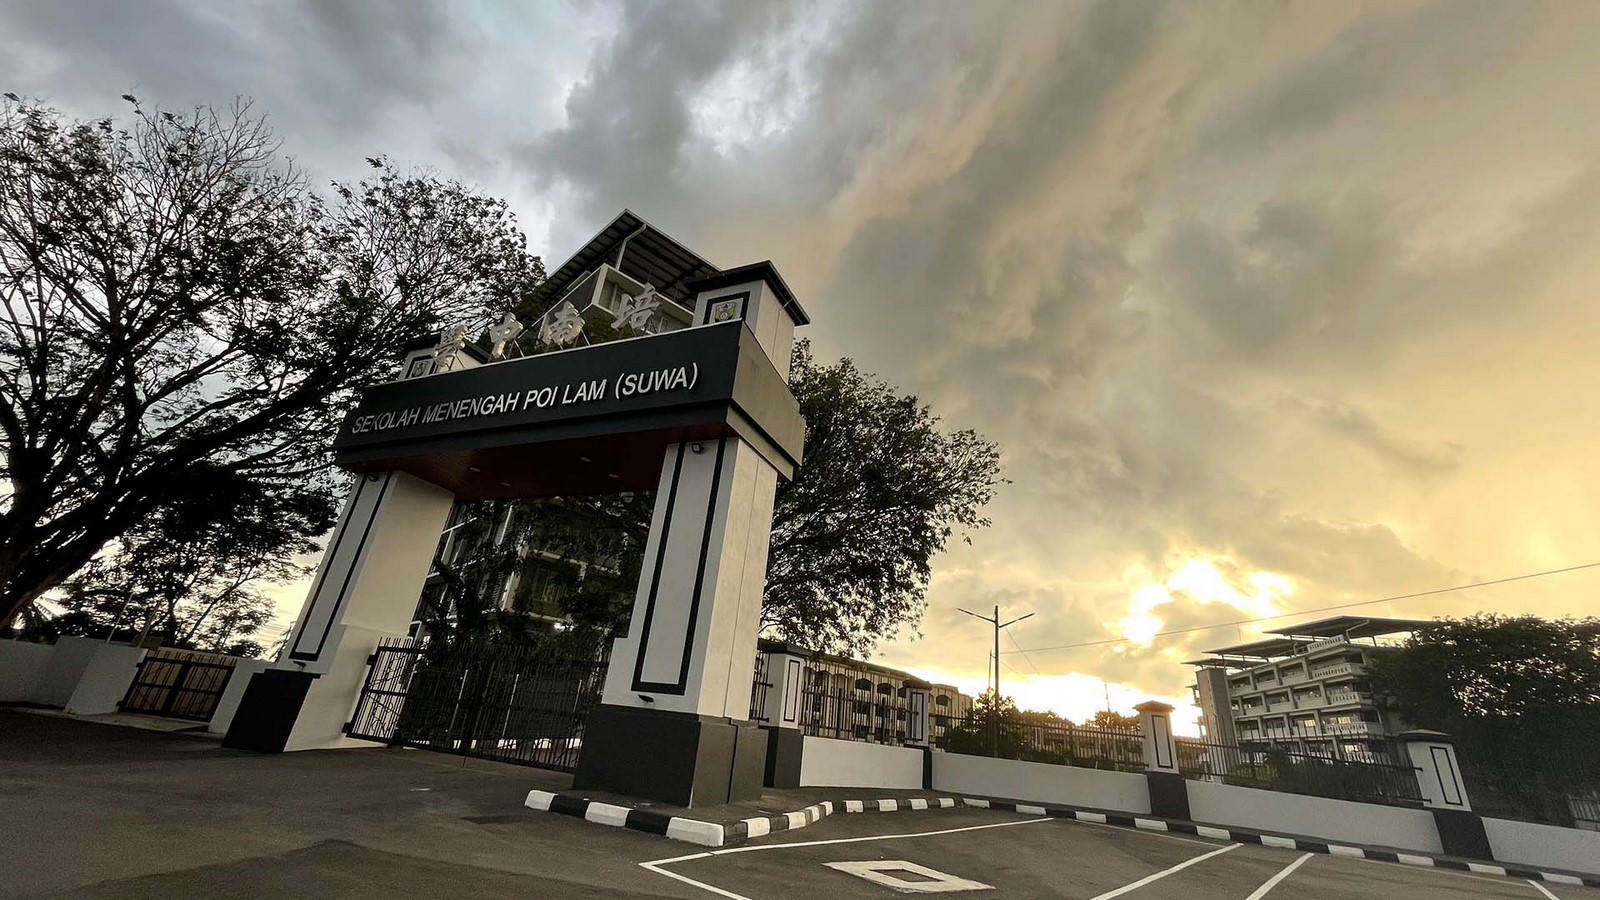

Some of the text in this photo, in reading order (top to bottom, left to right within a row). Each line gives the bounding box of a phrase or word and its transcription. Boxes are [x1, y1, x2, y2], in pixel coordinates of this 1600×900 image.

[352, 362, 698, 434] SEKOLAH MENENGAH POI LAM (SUWA)
